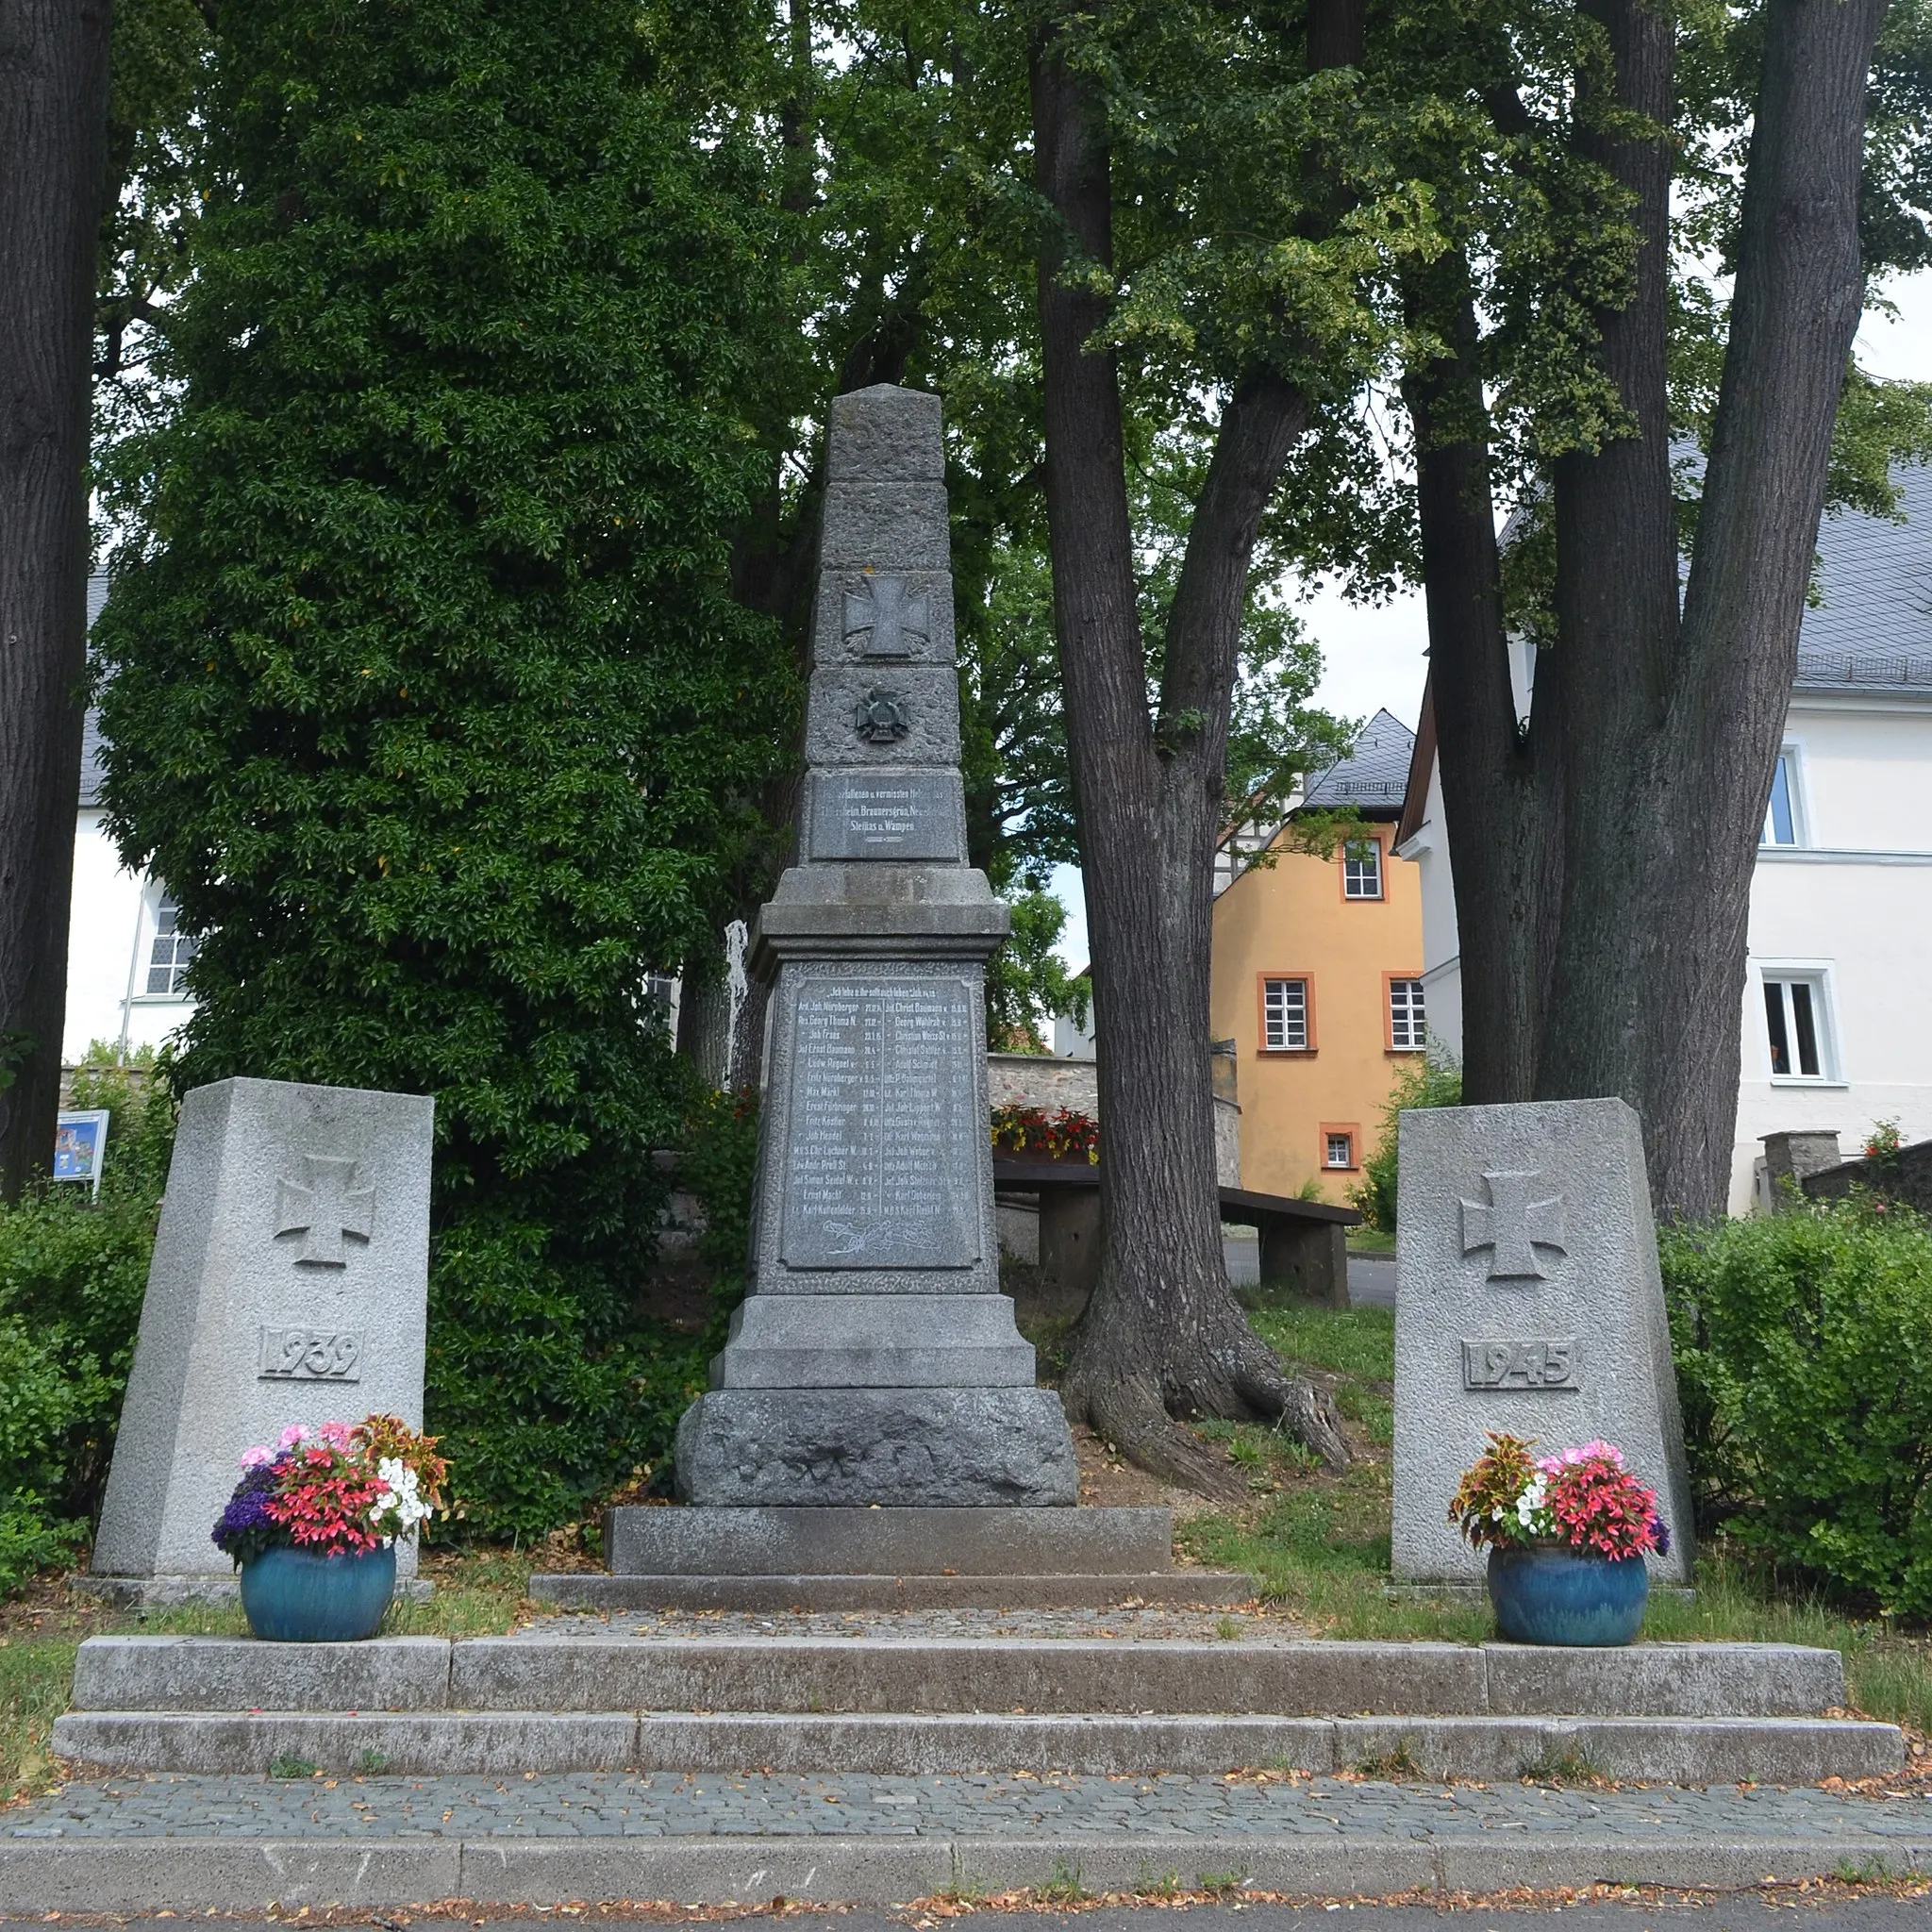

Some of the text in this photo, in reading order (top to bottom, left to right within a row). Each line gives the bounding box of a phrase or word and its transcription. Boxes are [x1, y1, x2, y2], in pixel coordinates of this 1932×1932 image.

[876, 790, 908, 799] vermissten
[809, 1014, 828, 1027] Georg
[829, 1014, 849, 1026] Thoma
[895, 1016, 914, 1029] Georg
[808, 1042, 825, 1055] Ernst
[826, 1042, 856, 1055] Baumann
[263, 1329, 359, 1376] 1939
[1468, 1342, 1571, 1385] 1945
